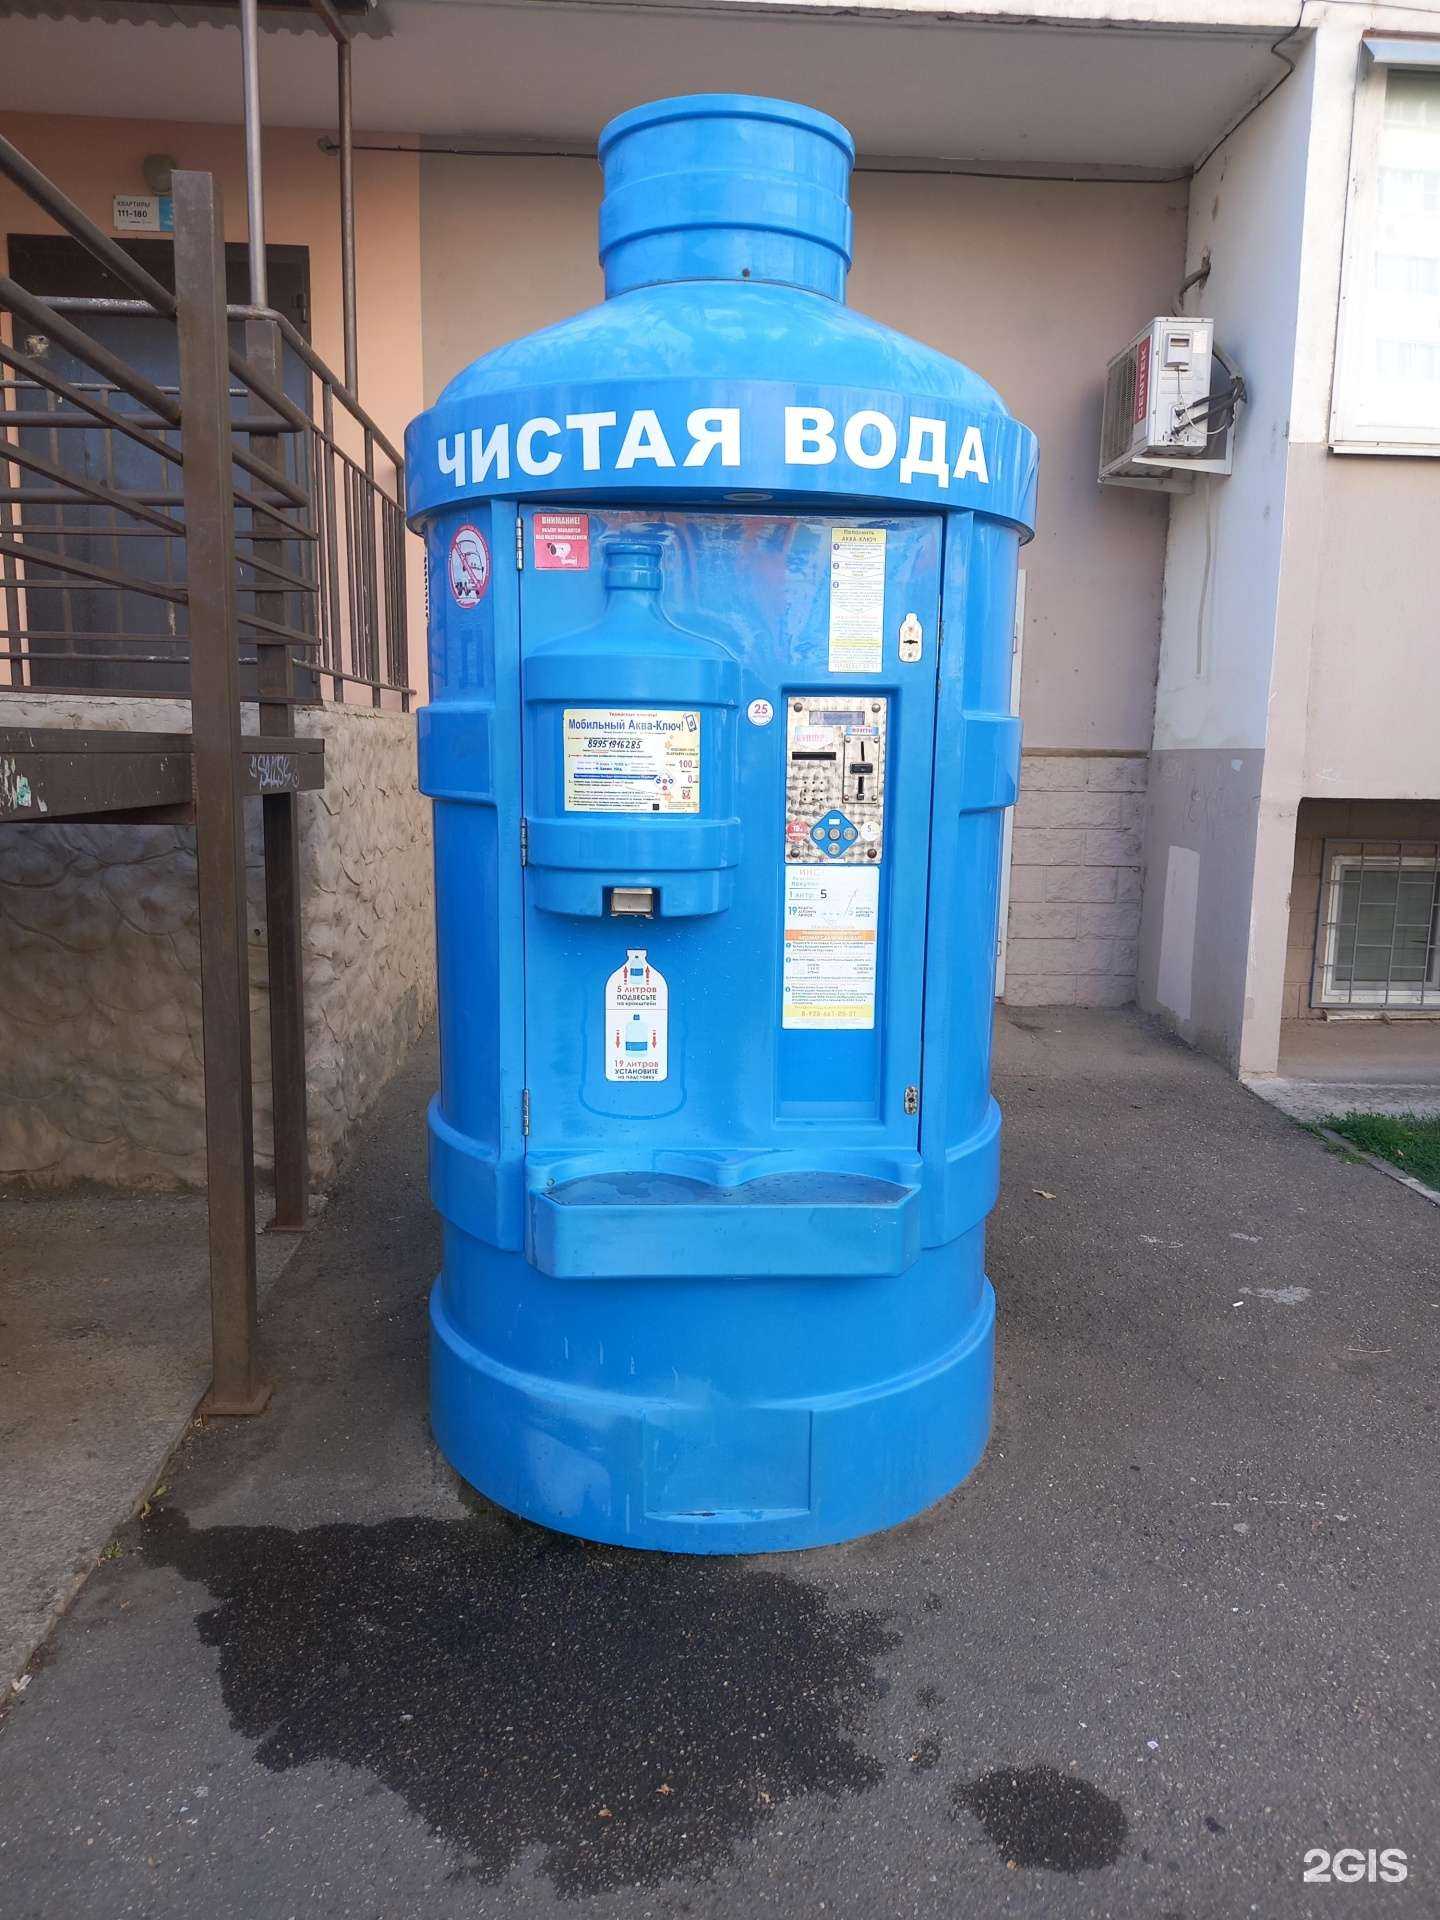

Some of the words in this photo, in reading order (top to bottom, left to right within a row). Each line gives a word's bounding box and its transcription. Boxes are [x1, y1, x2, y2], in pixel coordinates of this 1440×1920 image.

[117, 209, 148, 218] 111-180
[1138, 346, 1147, 419] CENTEK
[438, 407, 741, 486] ЧИСТАЯ
[784, 406, 989, 488] ВОДА
[541, 516, 580, 525] ВНИМАНИЕ!
[754, 703, 768, 715] 25
[568, 718, 625, 731] Мобильный
[628, 719, 684, 732] Аква-Ключ!
[678, 759, 693, 769] 100
[820, 889, 828, 899] 5
[616, 985, 623, 993] 5
[624, 986, 658, 994] литров
[614, 1059, 625, 1068] 19
[626, 1061, 659, 1069] литров
